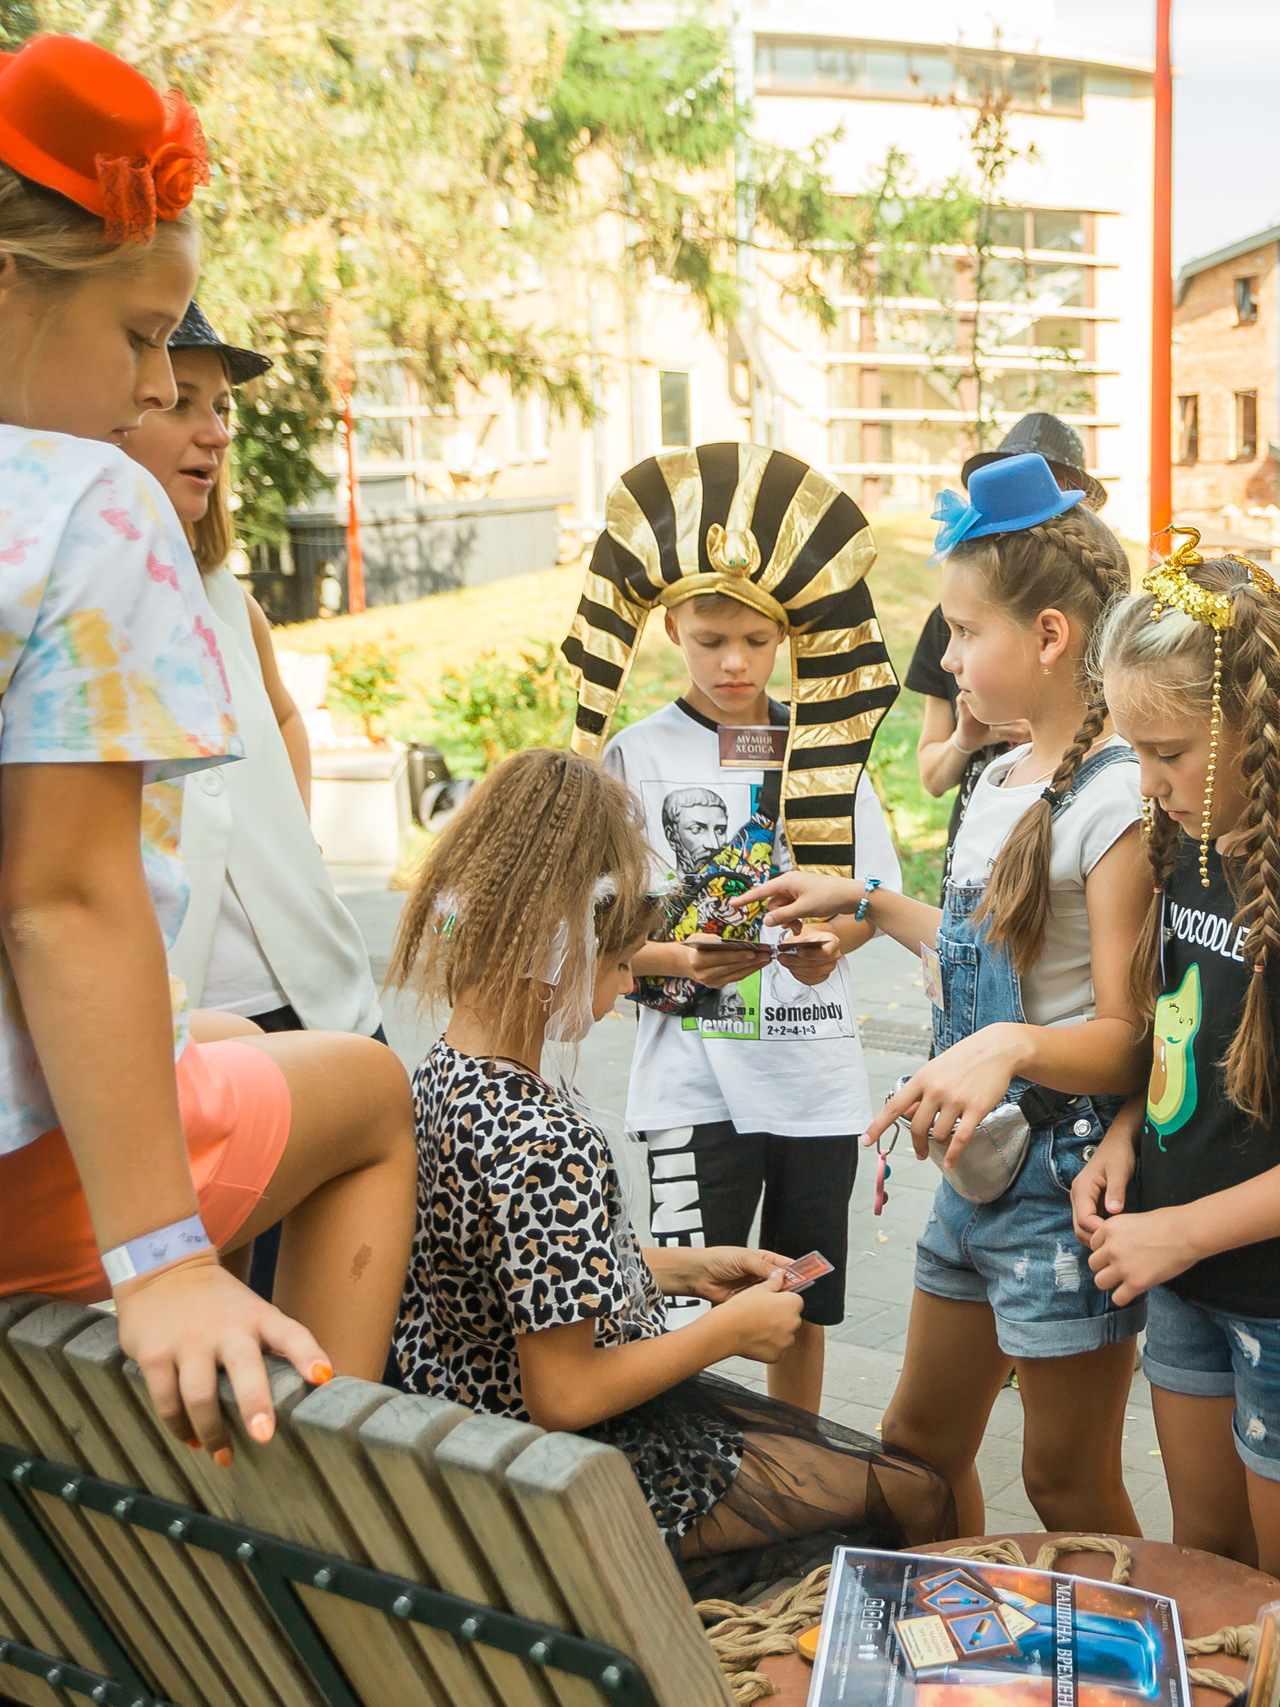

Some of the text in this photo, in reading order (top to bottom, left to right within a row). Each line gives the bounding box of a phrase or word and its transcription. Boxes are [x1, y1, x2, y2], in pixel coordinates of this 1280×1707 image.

[736, 735, 773, 745] МУМИЯ
[735, 744, 775, 754] ХЕОПСА
[764, 1002, 844, 1022] somebody
[767, 1025, 817, 1035] 2+2=4-1=3
[1056, 1582, 1073, 1644] МАШИНА
